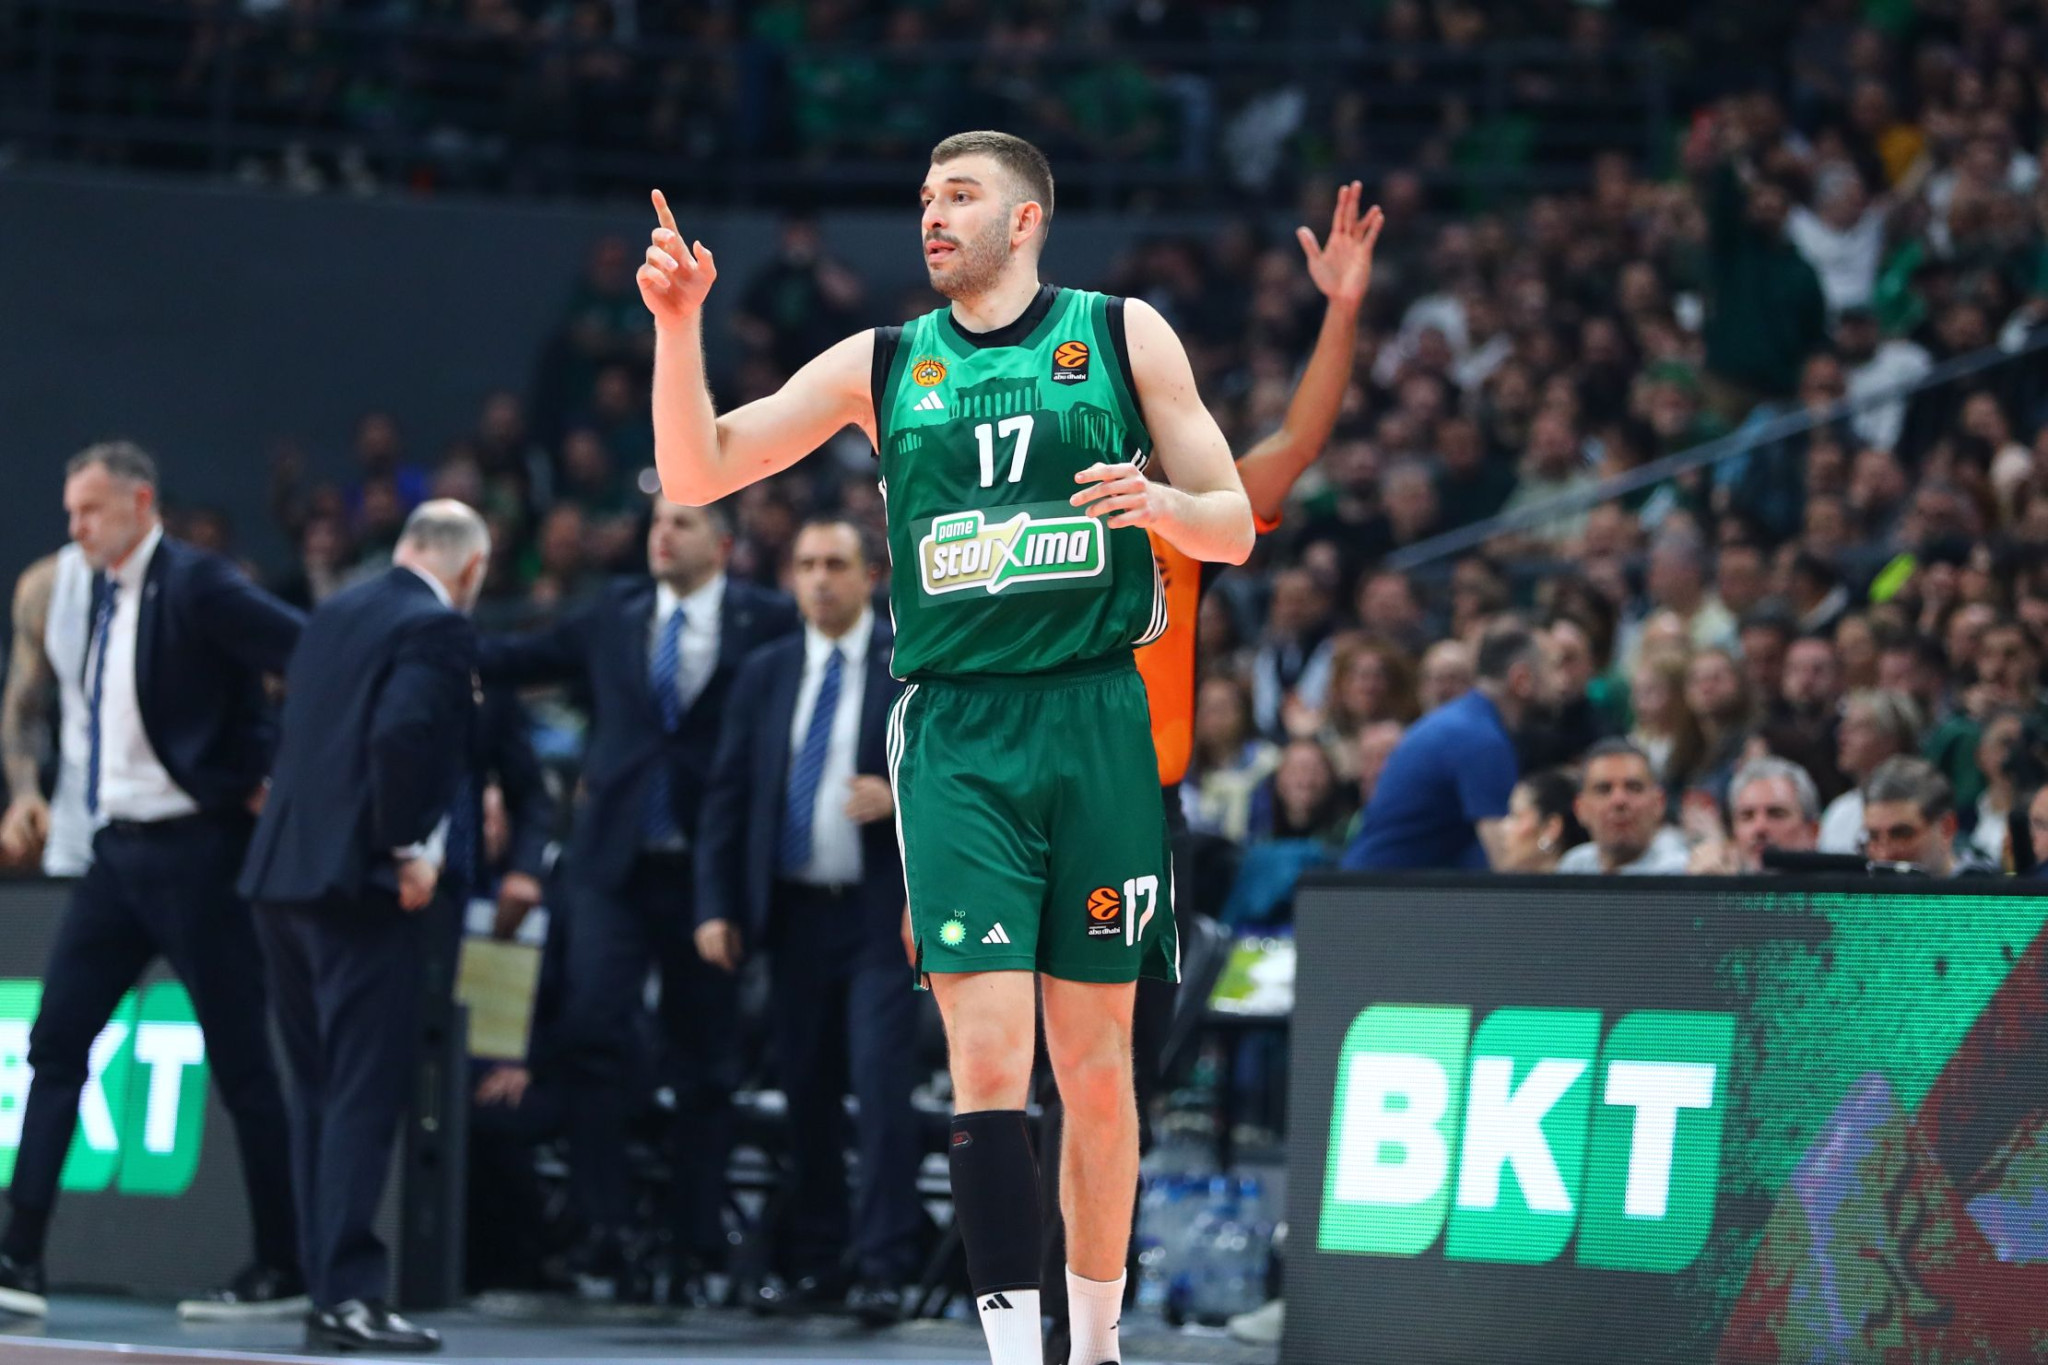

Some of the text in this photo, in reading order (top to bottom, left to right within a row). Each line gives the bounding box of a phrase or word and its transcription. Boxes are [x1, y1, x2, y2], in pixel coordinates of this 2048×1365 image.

[974, 415, 1034, 488] 17
[938, 520, 974, 541] pame
[954, 909, 966, 918] bp
[1123, 874, 1159, 947] 17
[1332, 1052, 1718, 1220] BKT
